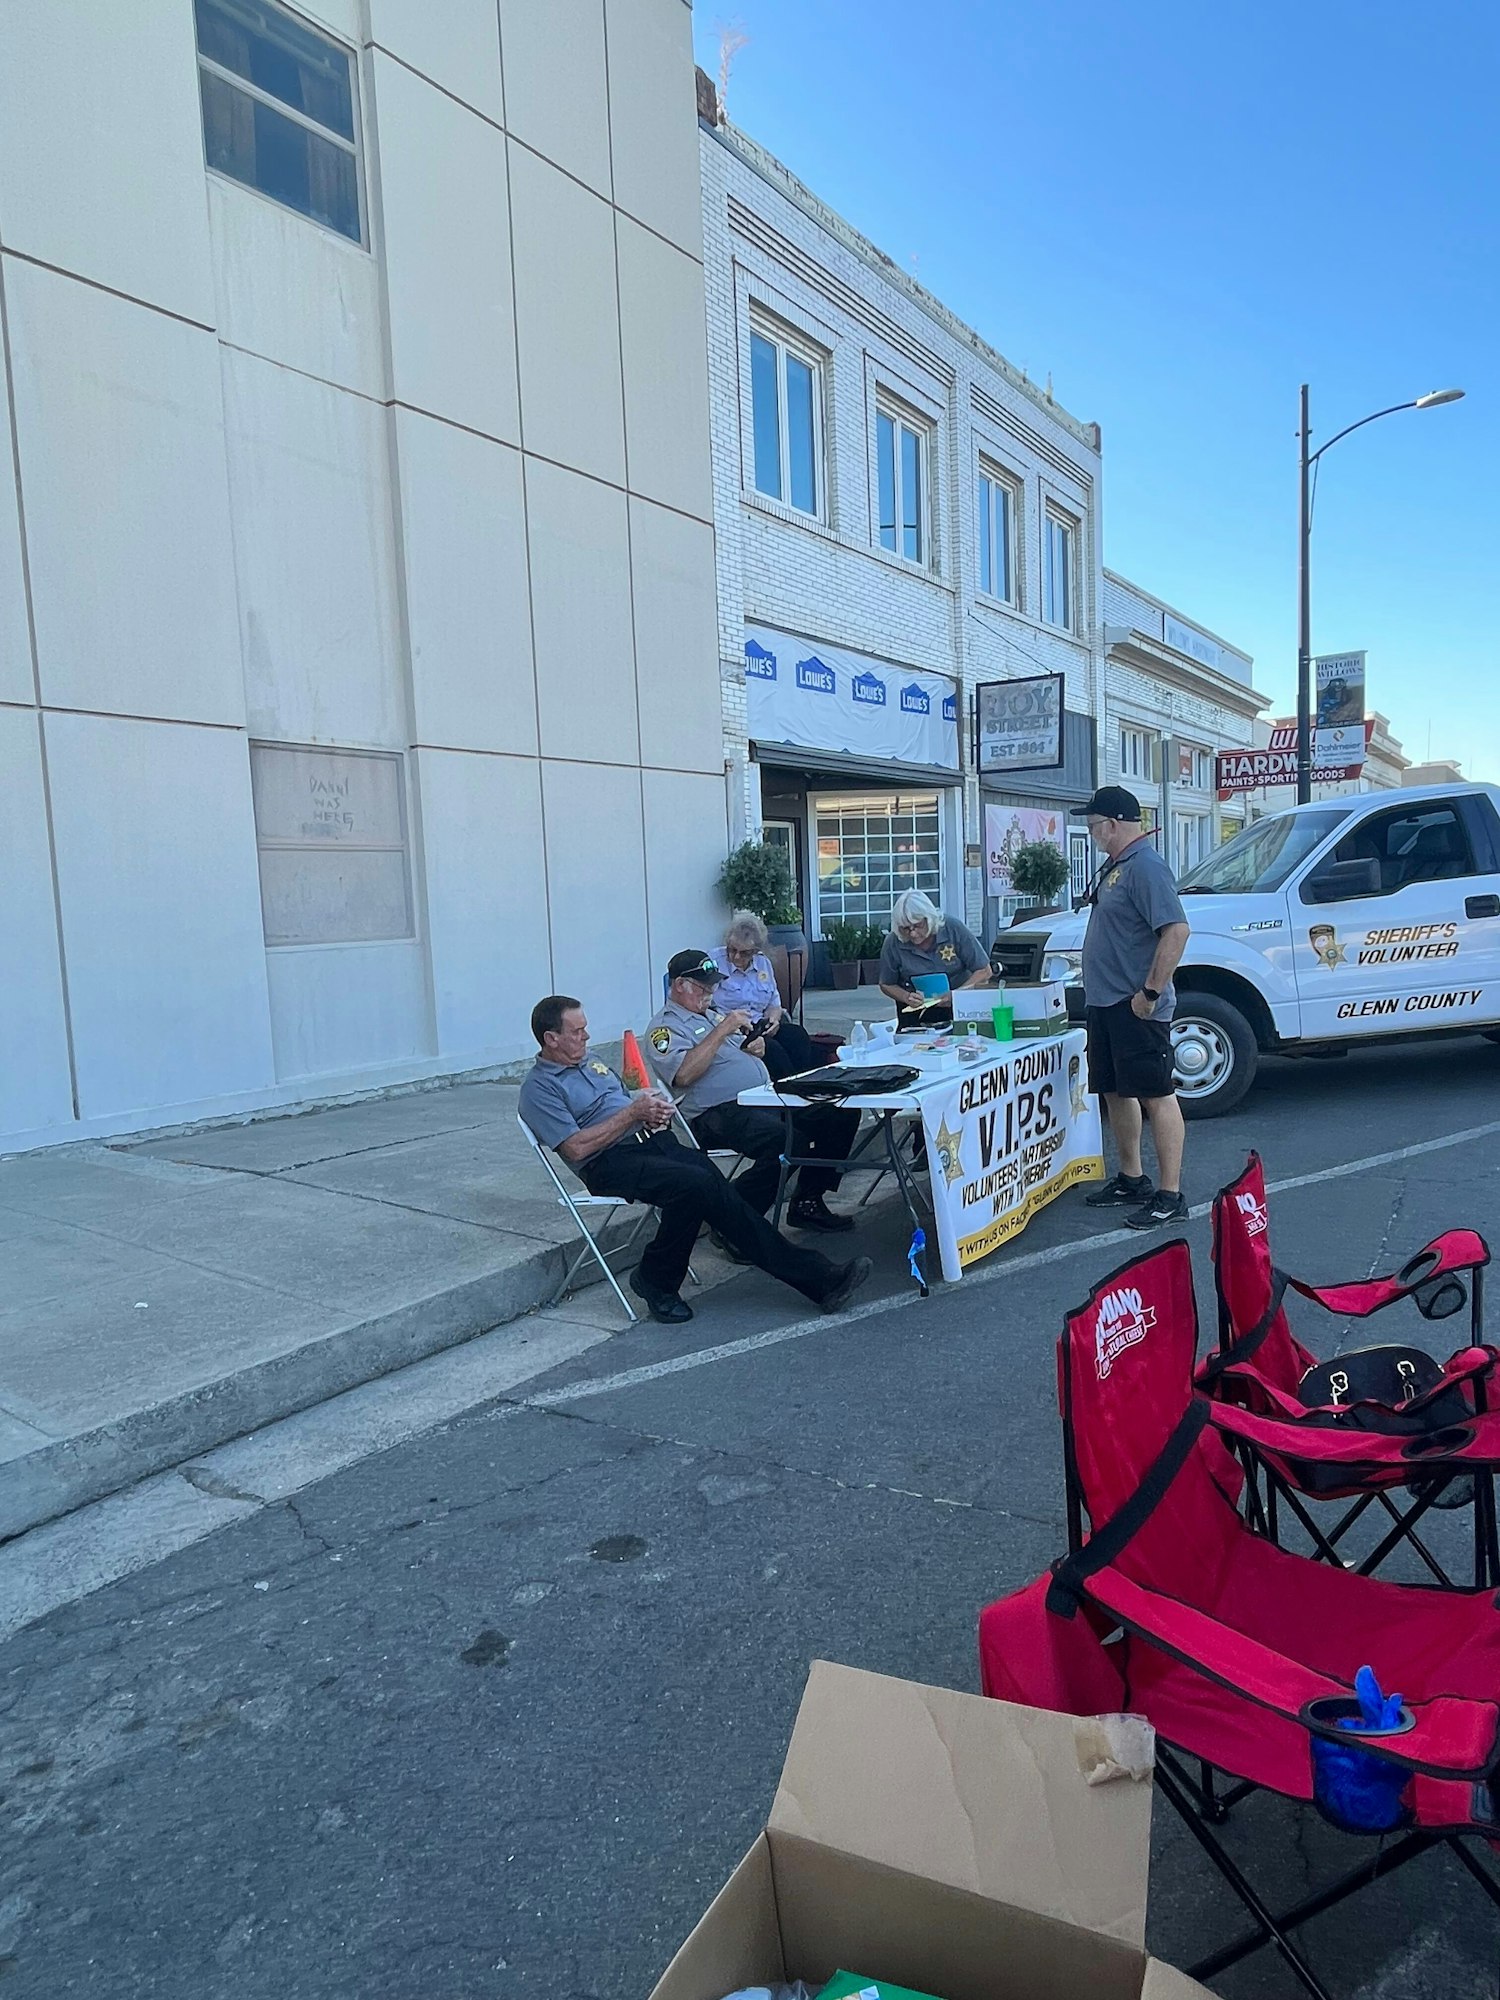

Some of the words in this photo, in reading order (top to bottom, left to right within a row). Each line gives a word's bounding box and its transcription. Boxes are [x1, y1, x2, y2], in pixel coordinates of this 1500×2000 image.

[799, 666, 833, 691] LOWE'S
[855, 680, 884, 703] LOWE'S
[903, 691, 929, 712] LOWE'S
[1221, 751, 1318, 778] HARDW
[1310, 769, 1346, 781] GOODS
[1364, 922, 1458, 946] SHERIFF'S
[1357, 941, 1460, 966] VOLUNTEER
[957, 1008, 993, 1019] busines
[1336, 998, 1399, 1019] GLENN
[1403, 990, 1482, 1012] COUNTY
[959, 1062, 1009, 1114] GLENN
[1013, 1041, 1064, 1086] COUNTY
[961, 1160, 1018, 1209] VOLUNTEERS
[992, 1184, 1014, 1217] WITH
[966, 1235, 989, 1255] WITH
[998, 1221, 1010, 1236] ON
